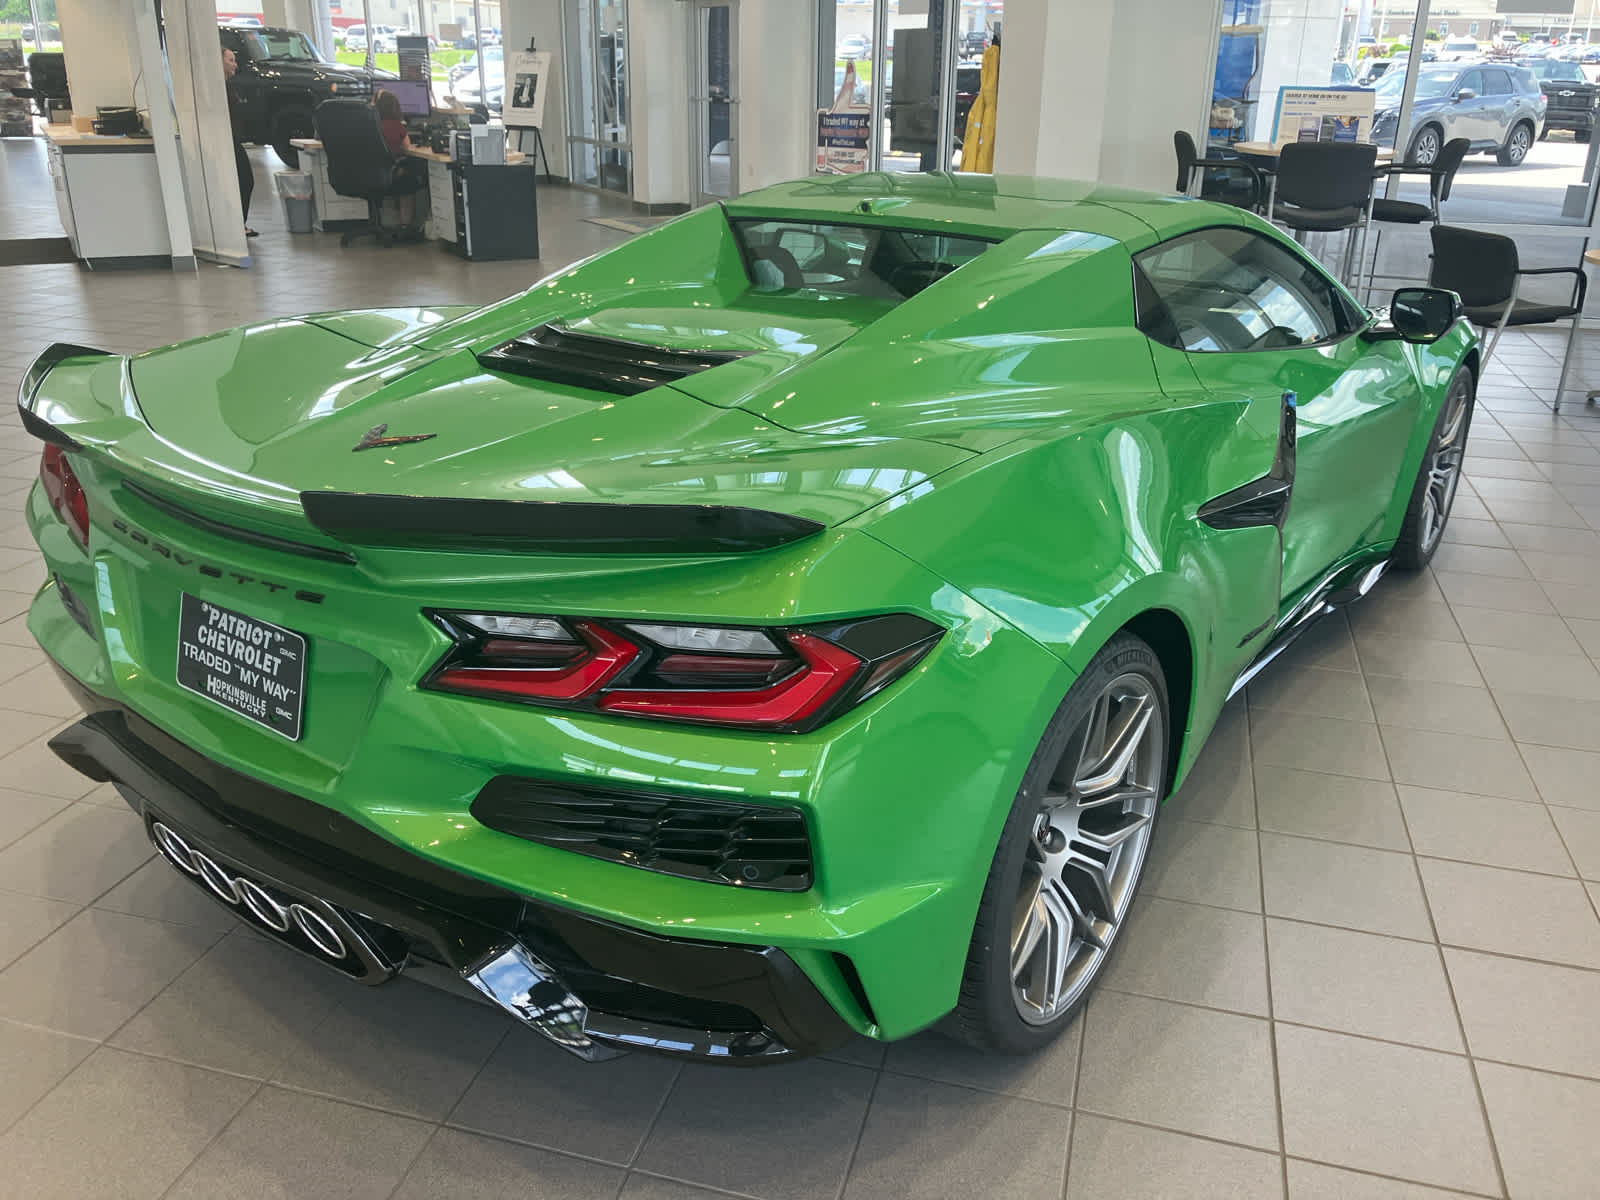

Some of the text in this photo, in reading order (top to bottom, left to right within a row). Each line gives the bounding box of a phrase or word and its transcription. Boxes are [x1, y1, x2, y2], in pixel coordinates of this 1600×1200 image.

[112, 519, 326, 604] CORVETTE
[182, 641, 232, 675] TRADED
[197, 625, 282, 676] CHEVROLET
[206, 674, 267, 712] HOPKINSVILLE
[215, 689, 267, 718] KENTUCKY
